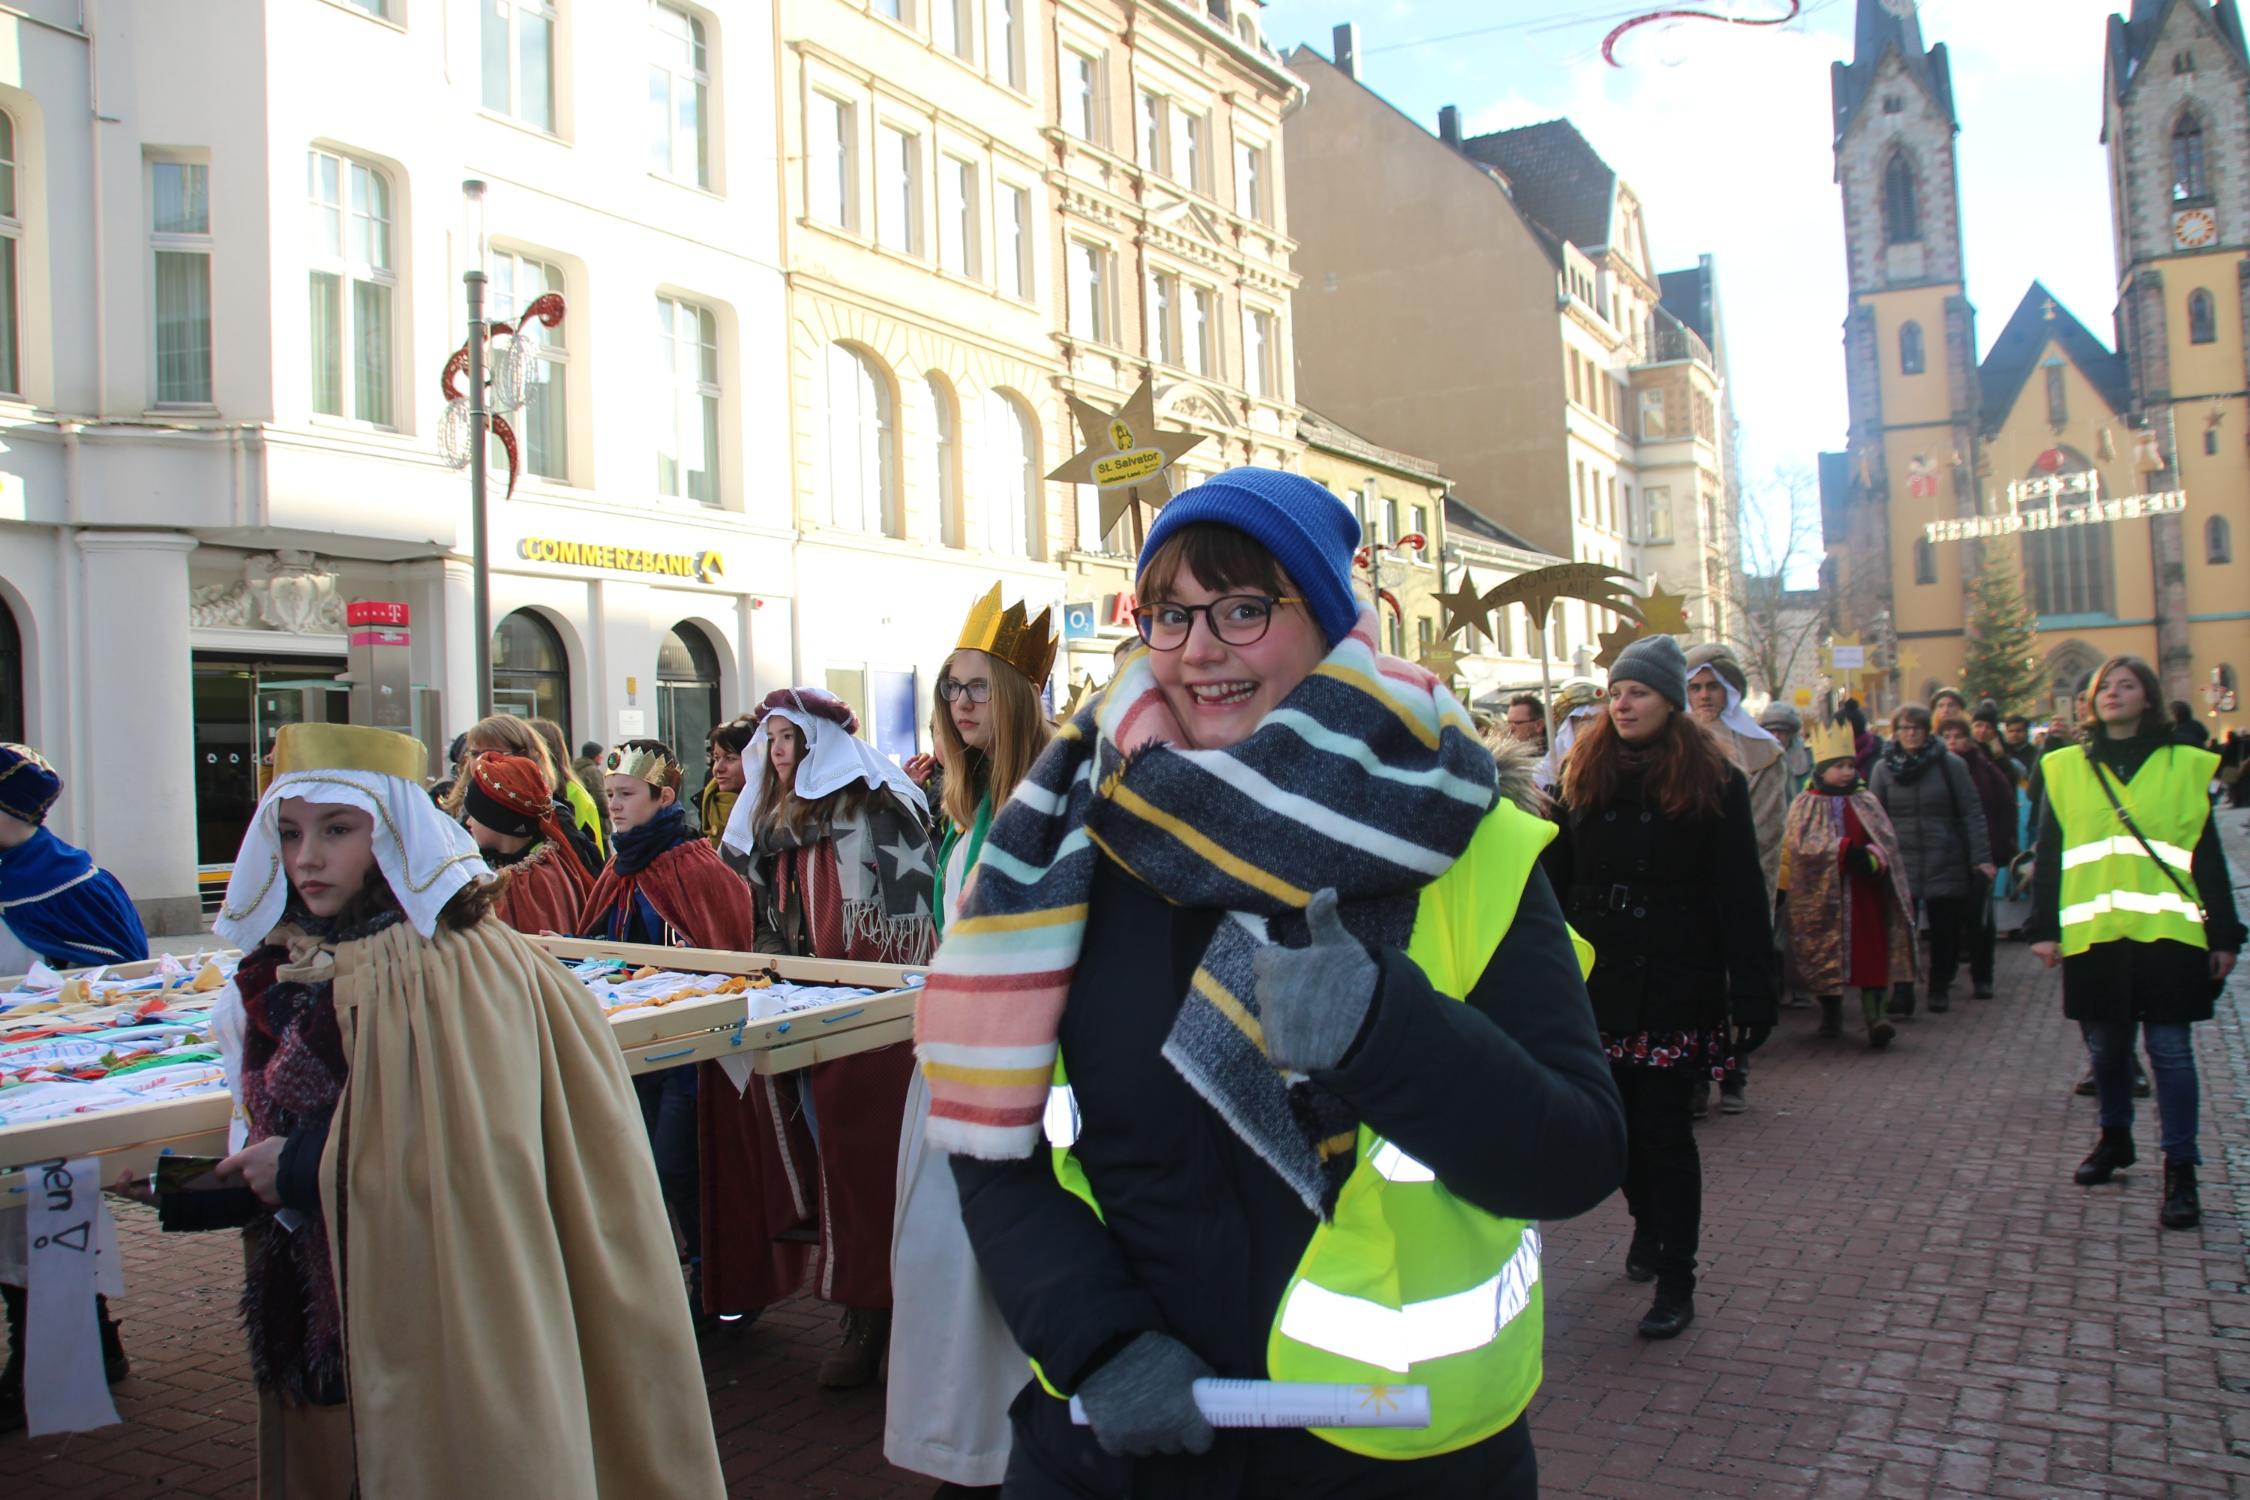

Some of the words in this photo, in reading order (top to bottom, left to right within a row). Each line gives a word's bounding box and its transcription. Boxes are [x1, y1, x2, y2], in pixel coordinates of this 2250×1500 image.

[1098, 463, 1112, 474] St.
[1114, 452, 1159, 470] Salvator
[523, 536, 696, 577] COMMERZBANK
